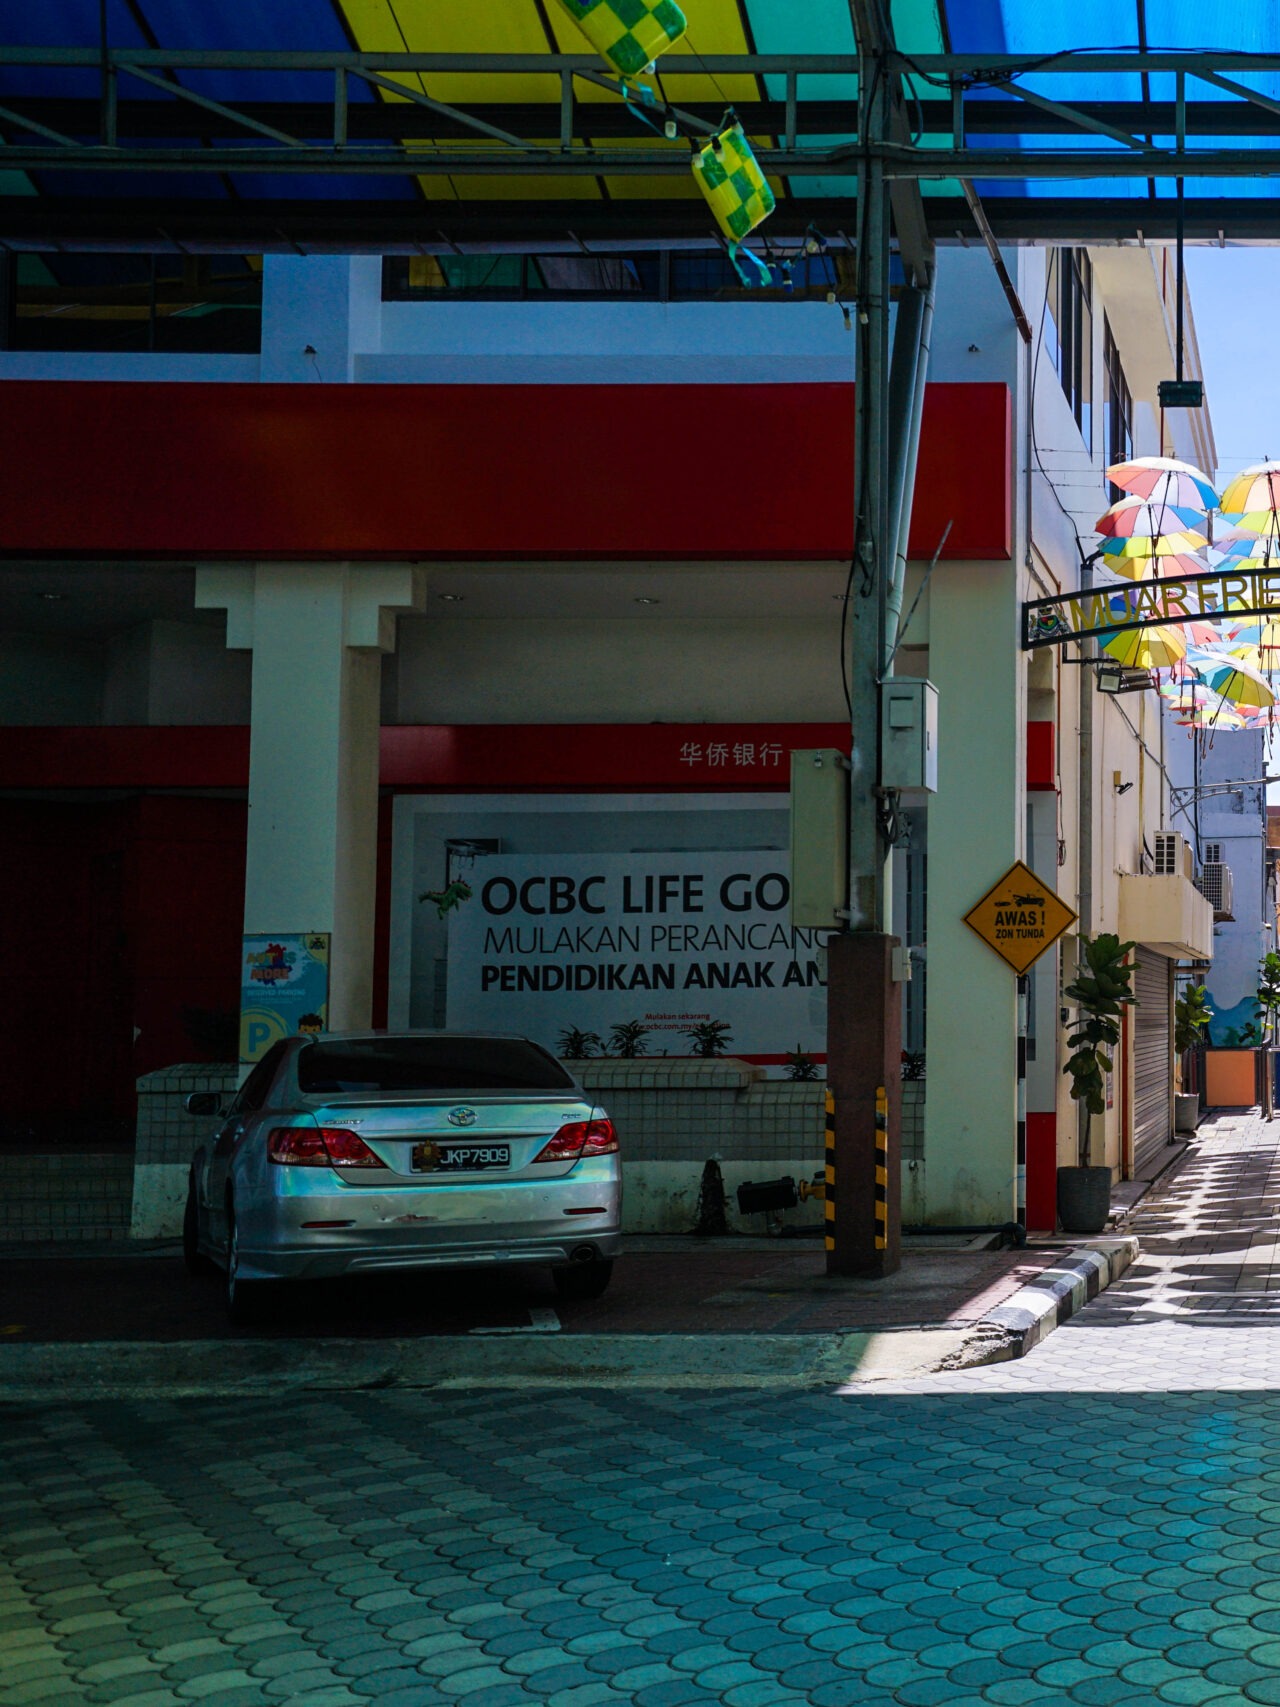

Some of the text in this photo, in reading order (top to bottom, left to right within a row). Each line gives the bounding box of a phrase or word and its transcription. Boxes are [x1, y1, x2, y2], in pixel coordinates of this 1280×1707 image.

[1069, 582, 1191, 632] MUAR
[680, 742, 783, 767] 华侨银行
[481, 873, 790, 915] OCBC LIFE GO
[994, 911, 1036, 926] AWAS
[484, 926, 639, 954] MULAKAN
[995, 929, 1045, 939] ZON TUNDA
[250, 968, 288, 980] MORE
[481, 963, 674, 992] PENDIDIKAN
[683, 962, 775, 990] ANAK
[645, 1012, 710, 1021] Mulakan sekarang
[249, 1022, 271, 1053] P
